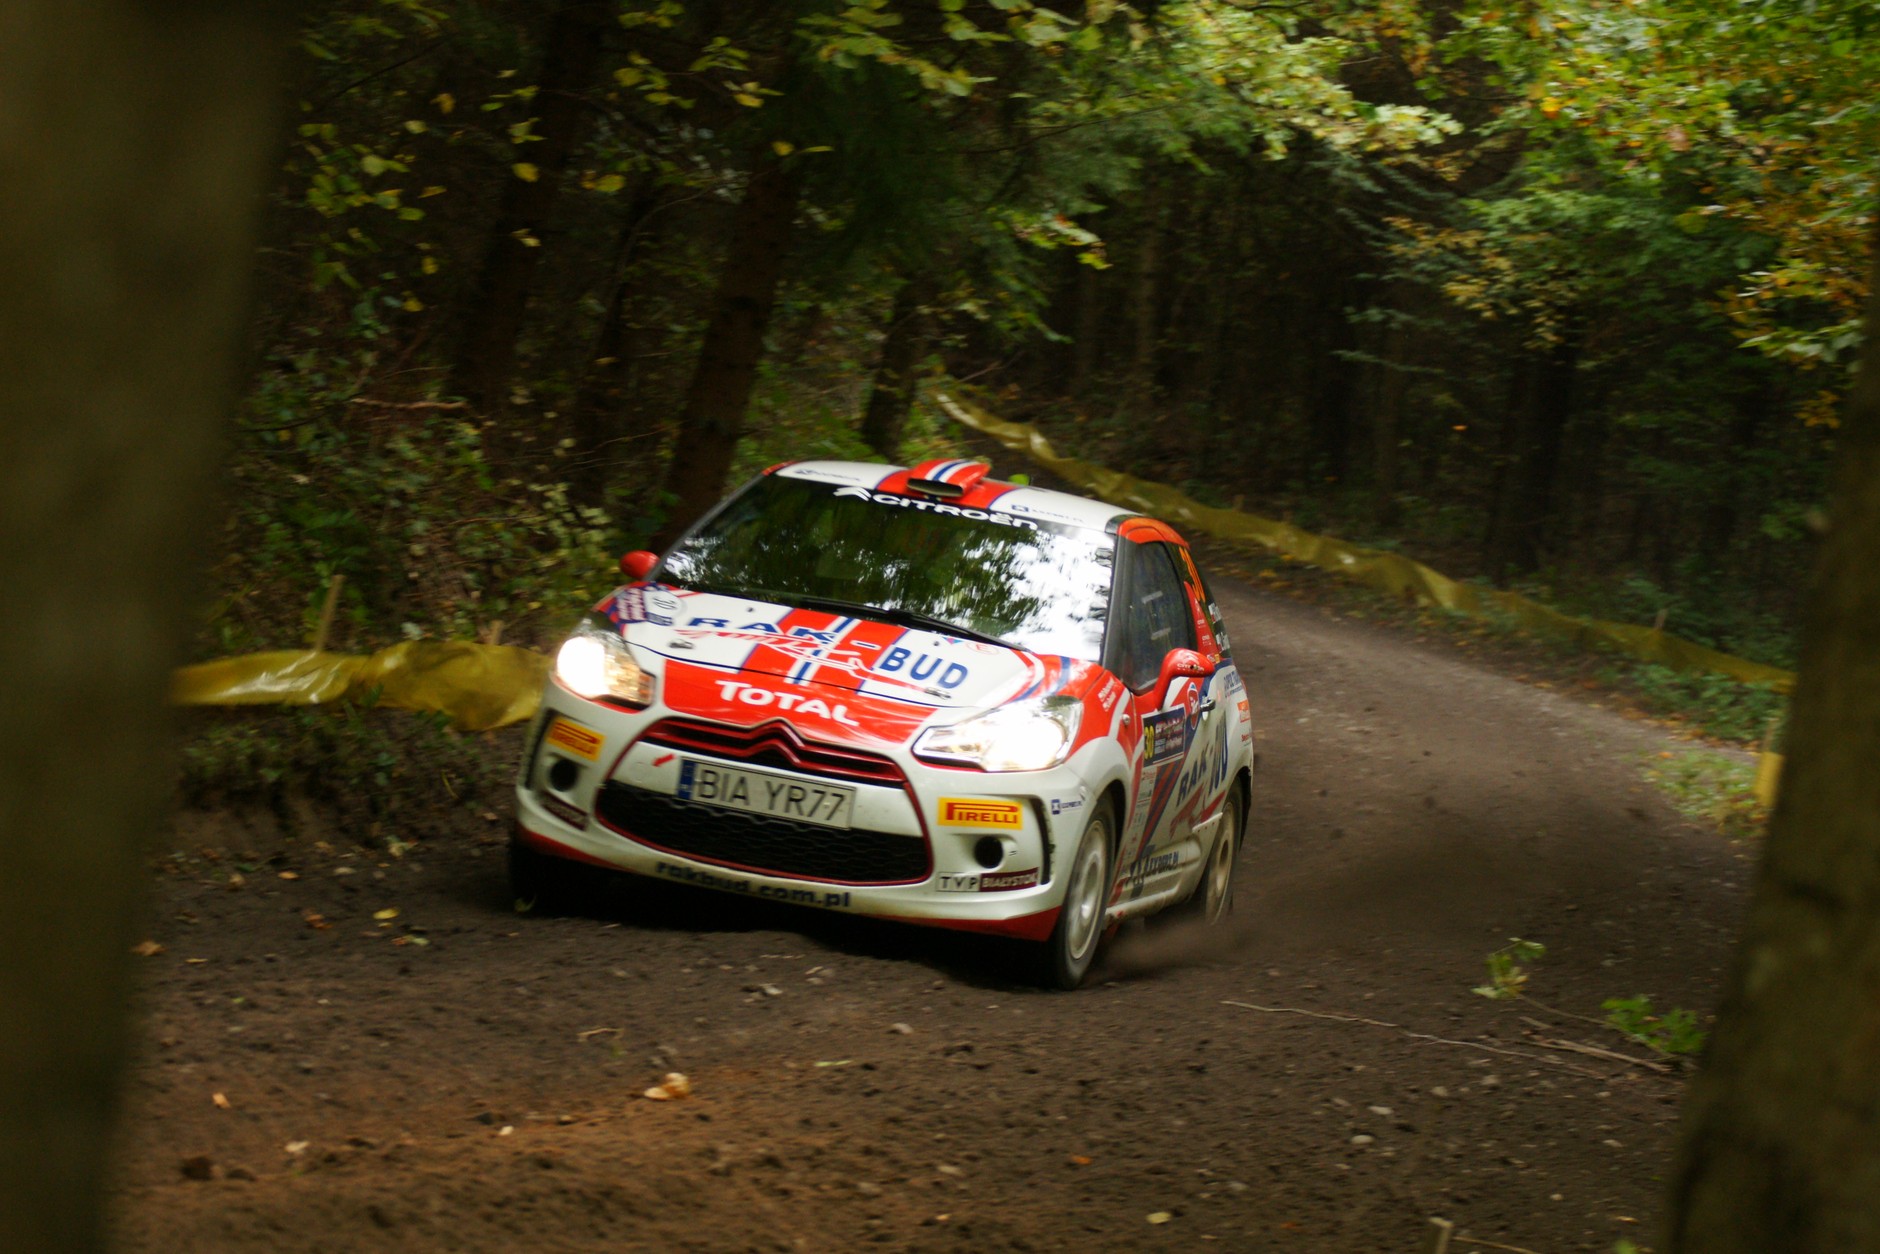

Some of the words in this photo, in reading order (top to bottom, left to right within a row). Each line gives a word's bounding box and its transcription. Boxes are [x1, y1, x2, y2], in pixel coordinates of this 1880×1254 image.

[715, 680, 860, 727] TOTAL
[698, 769, 751, 807] BIA
[763, 780, 846, 822] YR77
[945, 801, 1018, 825] PIRELLI
[940, 875, 978, 890] TVP
